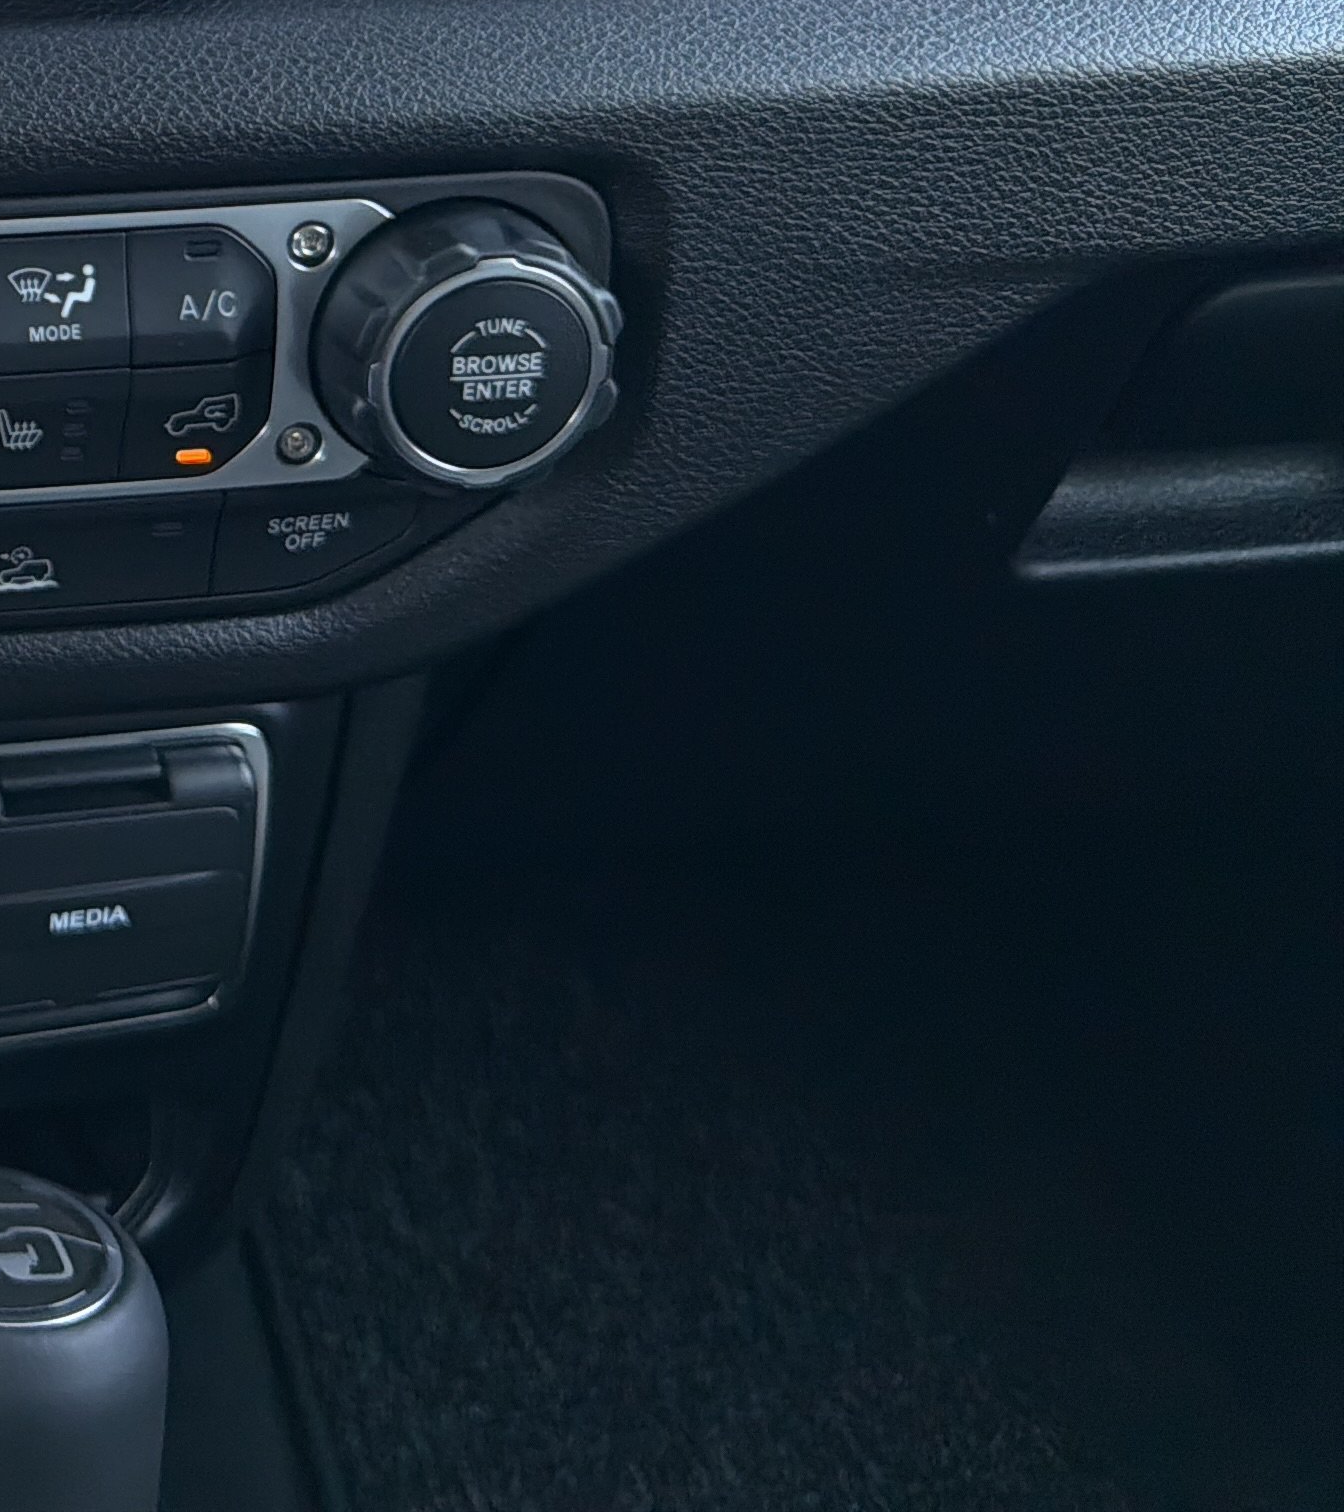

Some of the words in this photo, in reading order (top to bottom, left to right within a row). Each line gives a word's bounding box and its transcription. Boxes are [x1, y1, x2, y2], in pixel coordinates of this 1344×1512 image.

[179, 288, 238, 321] A/C
[29, 324, 82, 342] MODE
[475, 318, 526, 336] TUNE
[451, 352, 542, 374] BROWSE
[462, 380, 531, 399] ENTER
[459, 412, 525, 432] SCROLL
[267, 513, 350, 535] SCREEN
[284, 533, 324, 550] OFF
[49, 904, 132, 936] MEDIA
